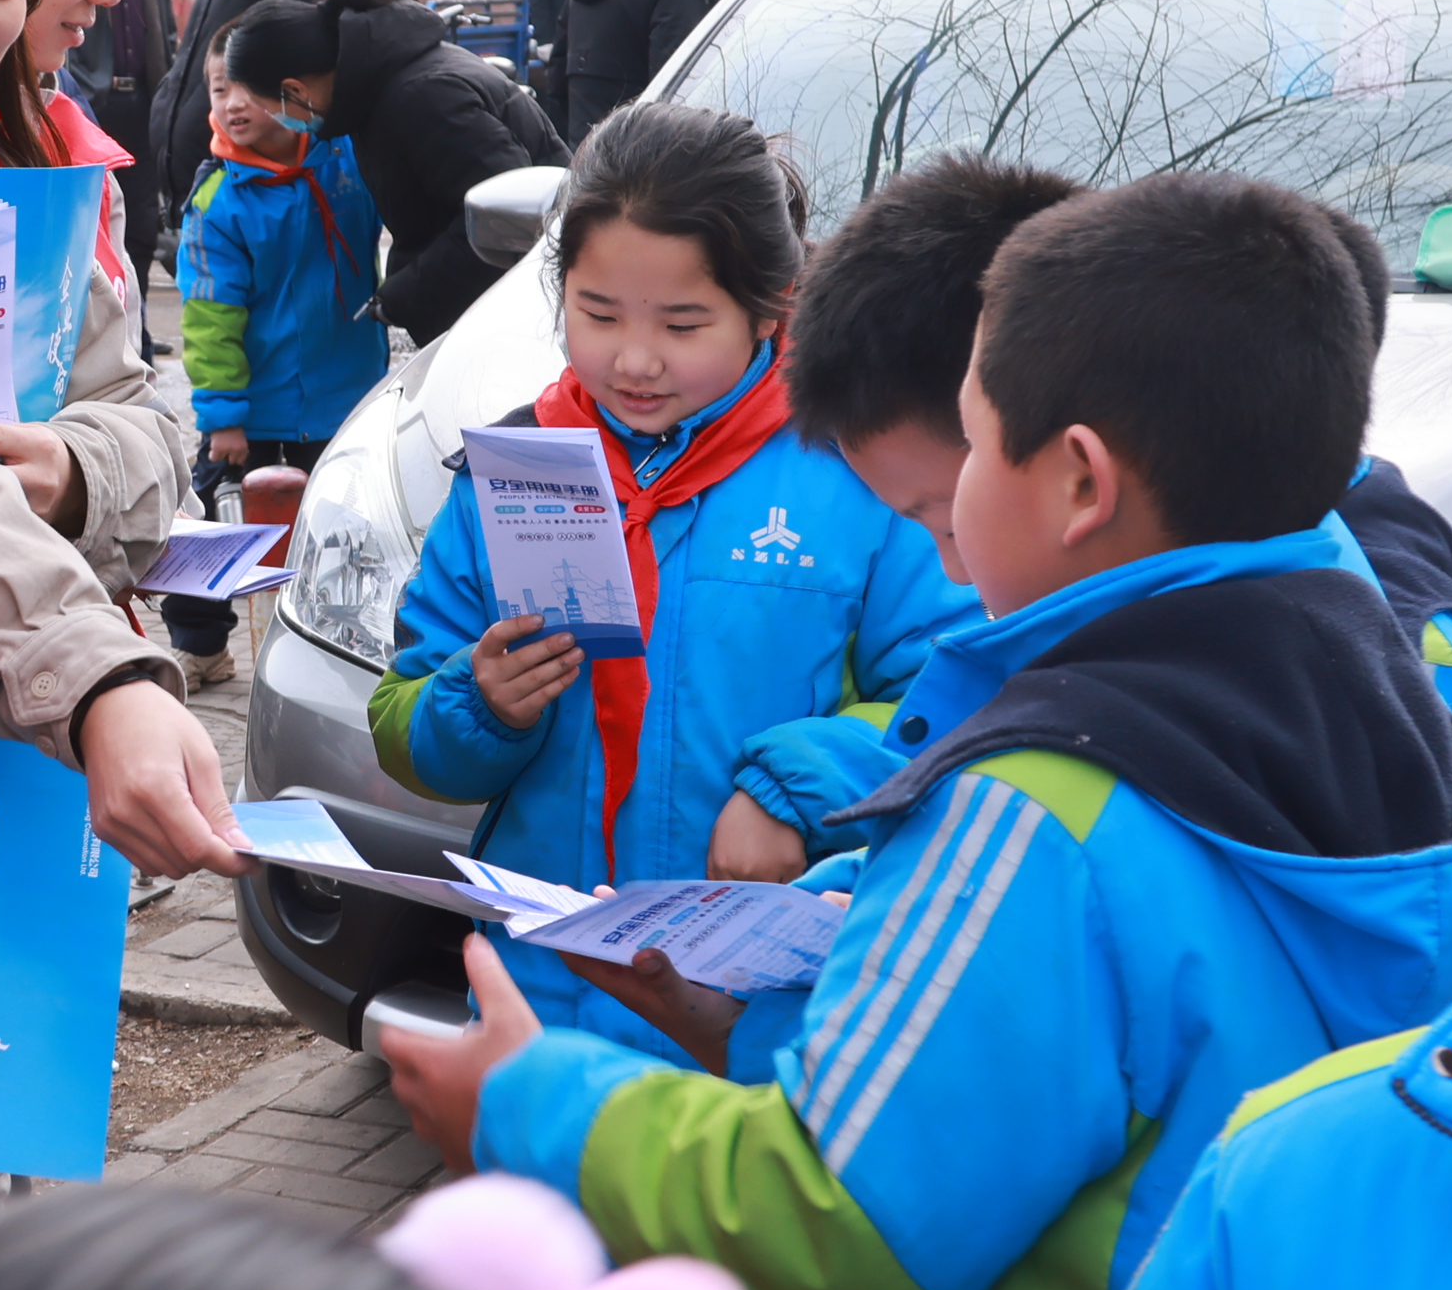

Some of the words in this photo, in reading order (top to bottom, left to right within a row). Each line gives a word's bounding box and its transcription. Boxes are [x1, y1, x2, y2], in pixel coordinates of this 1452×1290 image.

[488, 478, 600, 497] 安全用电手册
[88, 832, 102, 878] 有限公司
